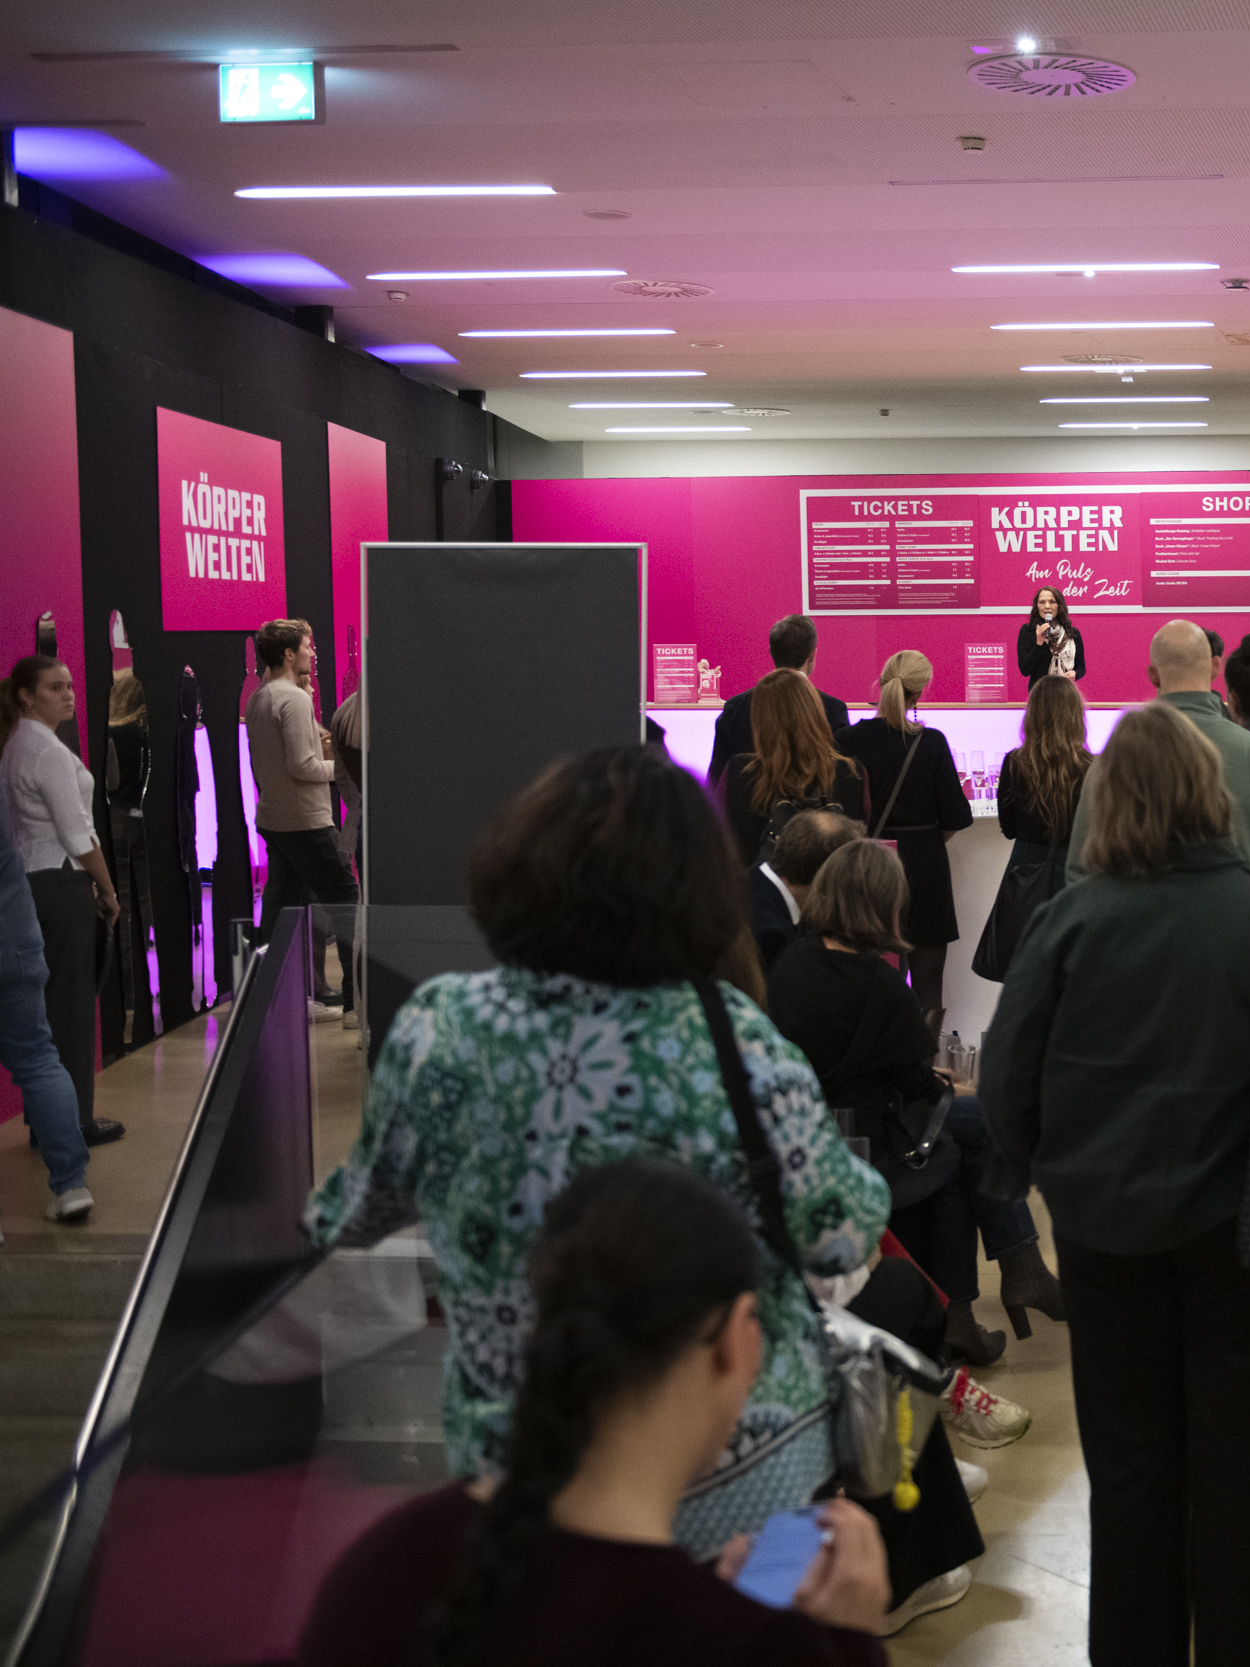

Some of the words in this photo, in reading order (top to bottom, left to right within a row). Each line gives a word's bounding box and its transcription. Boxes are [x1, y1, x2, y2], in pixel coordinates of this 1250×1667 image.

[182, 472, 266, 536] KÖRPER
[851, 500, 933, 516] TICKETS
[991, 501, 1124, 528] KÖRPER
[995, 530, 1118, 552] WELTEN
[186, 532, 265, 582] WELTEN
[1026, 562, 1052, 582] Am
[1056, 559, 1094, 582] Puls
[1062, 581, 1088, 597] der
[1093, 579, 1134, 599] Zeit
